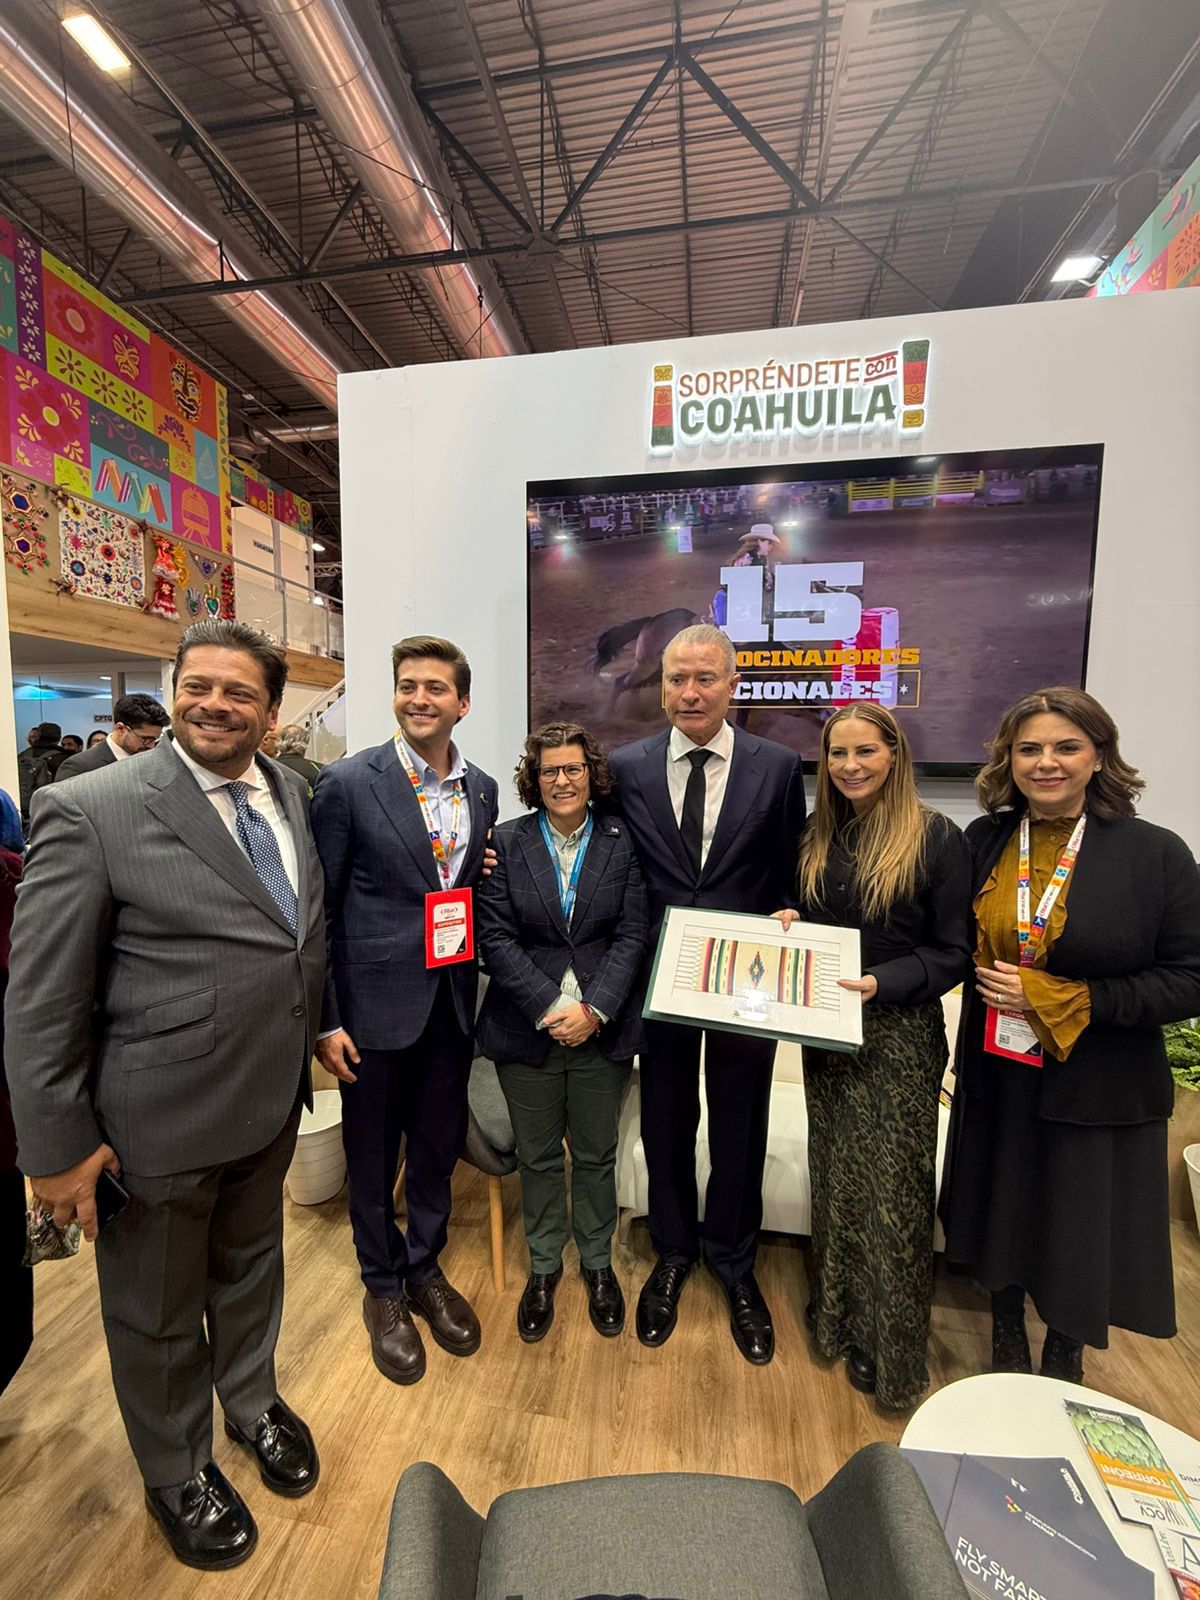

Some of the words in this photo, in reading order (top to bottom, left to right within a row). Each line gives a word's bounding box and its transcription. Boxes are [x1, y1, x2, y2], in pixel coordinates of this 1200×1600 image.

[679, 358, 861, 398] SORPRÉNDETE
[865, 354, 897, 376] con
[680, 384, 897, 435] COAHUILA
[720, 562, 864, 642] 15
[736, 648, 920, 667] OCINADORES
[733, 681, 894, 700] CIONALES
[954, 1548, 992, 1582] NOT
[957, 1536, 987, 1564] FLY
